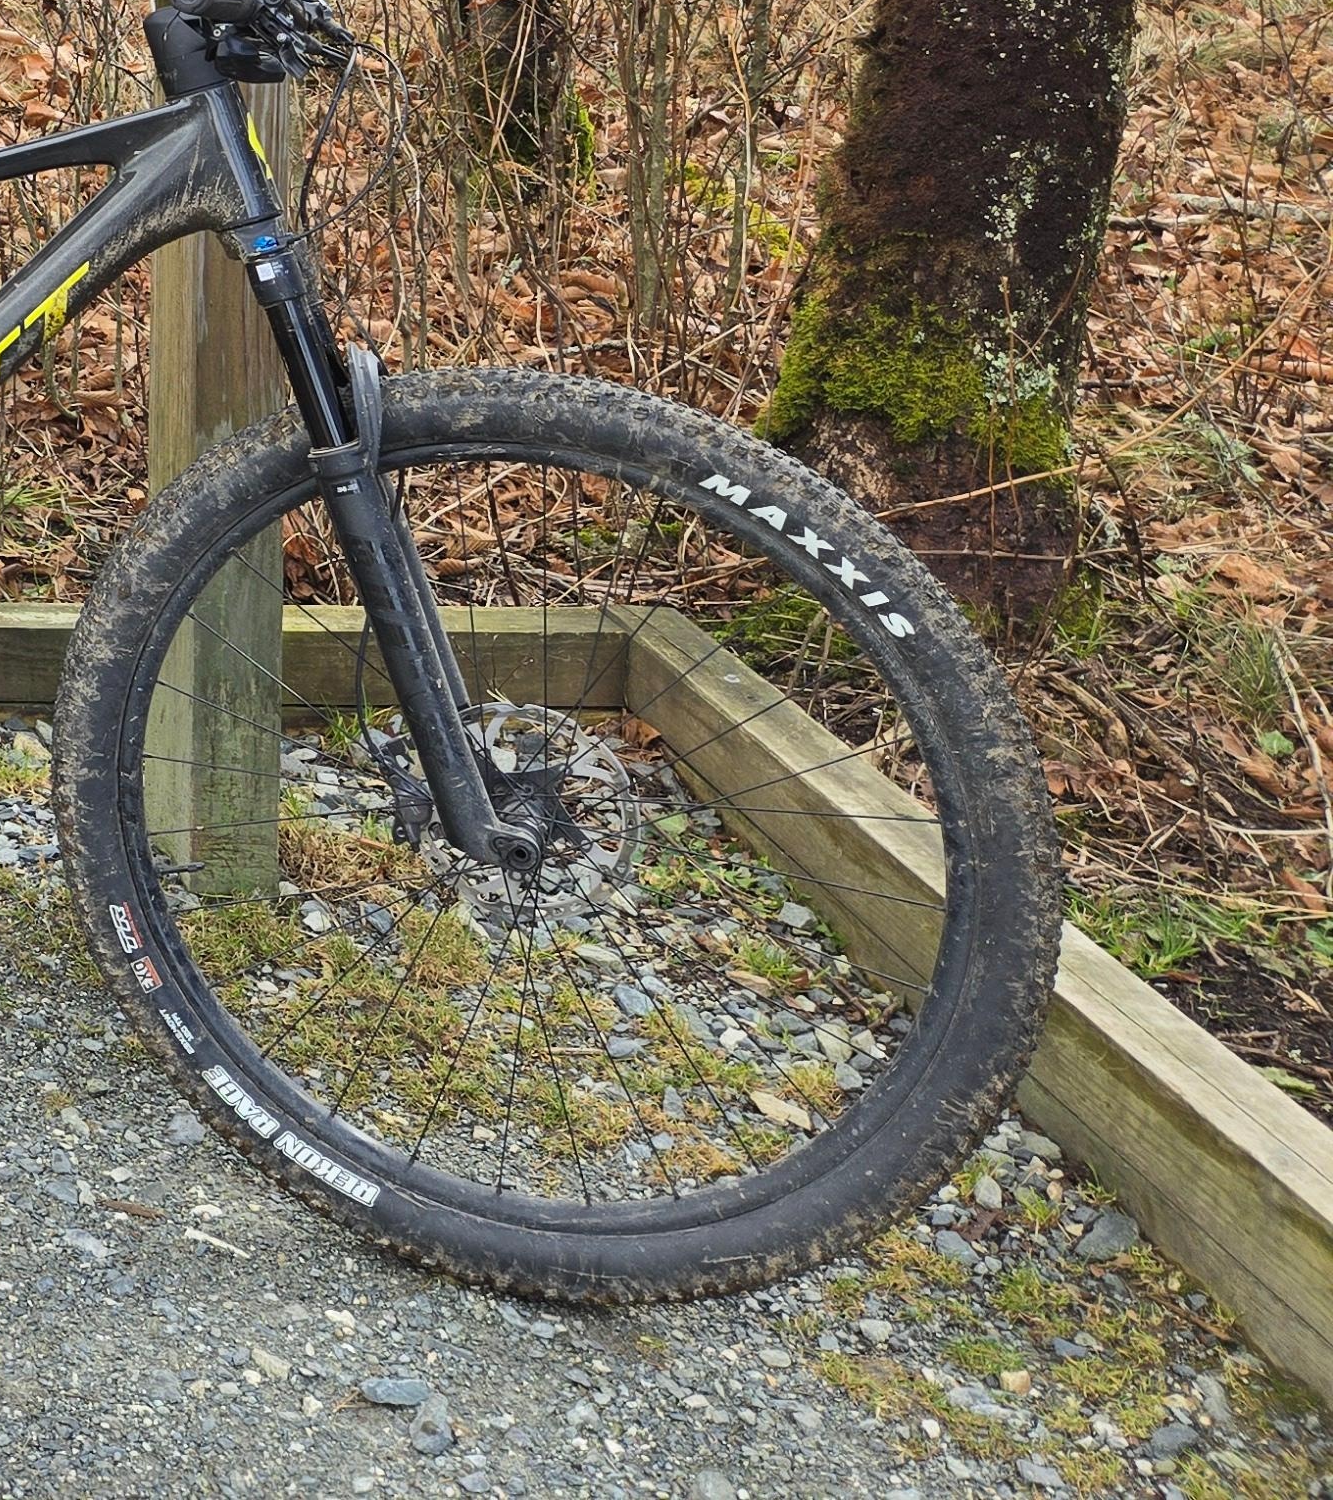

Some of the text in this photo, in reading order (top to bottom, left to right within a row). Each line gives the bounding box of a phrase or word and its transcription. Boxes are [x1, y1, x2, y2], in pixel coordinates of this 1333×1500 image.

[698, 474, 916, 638] MAXXIS
[133, 960, 155, 992] EXO
[201, 1064, 381, 1207] REKON RACE
